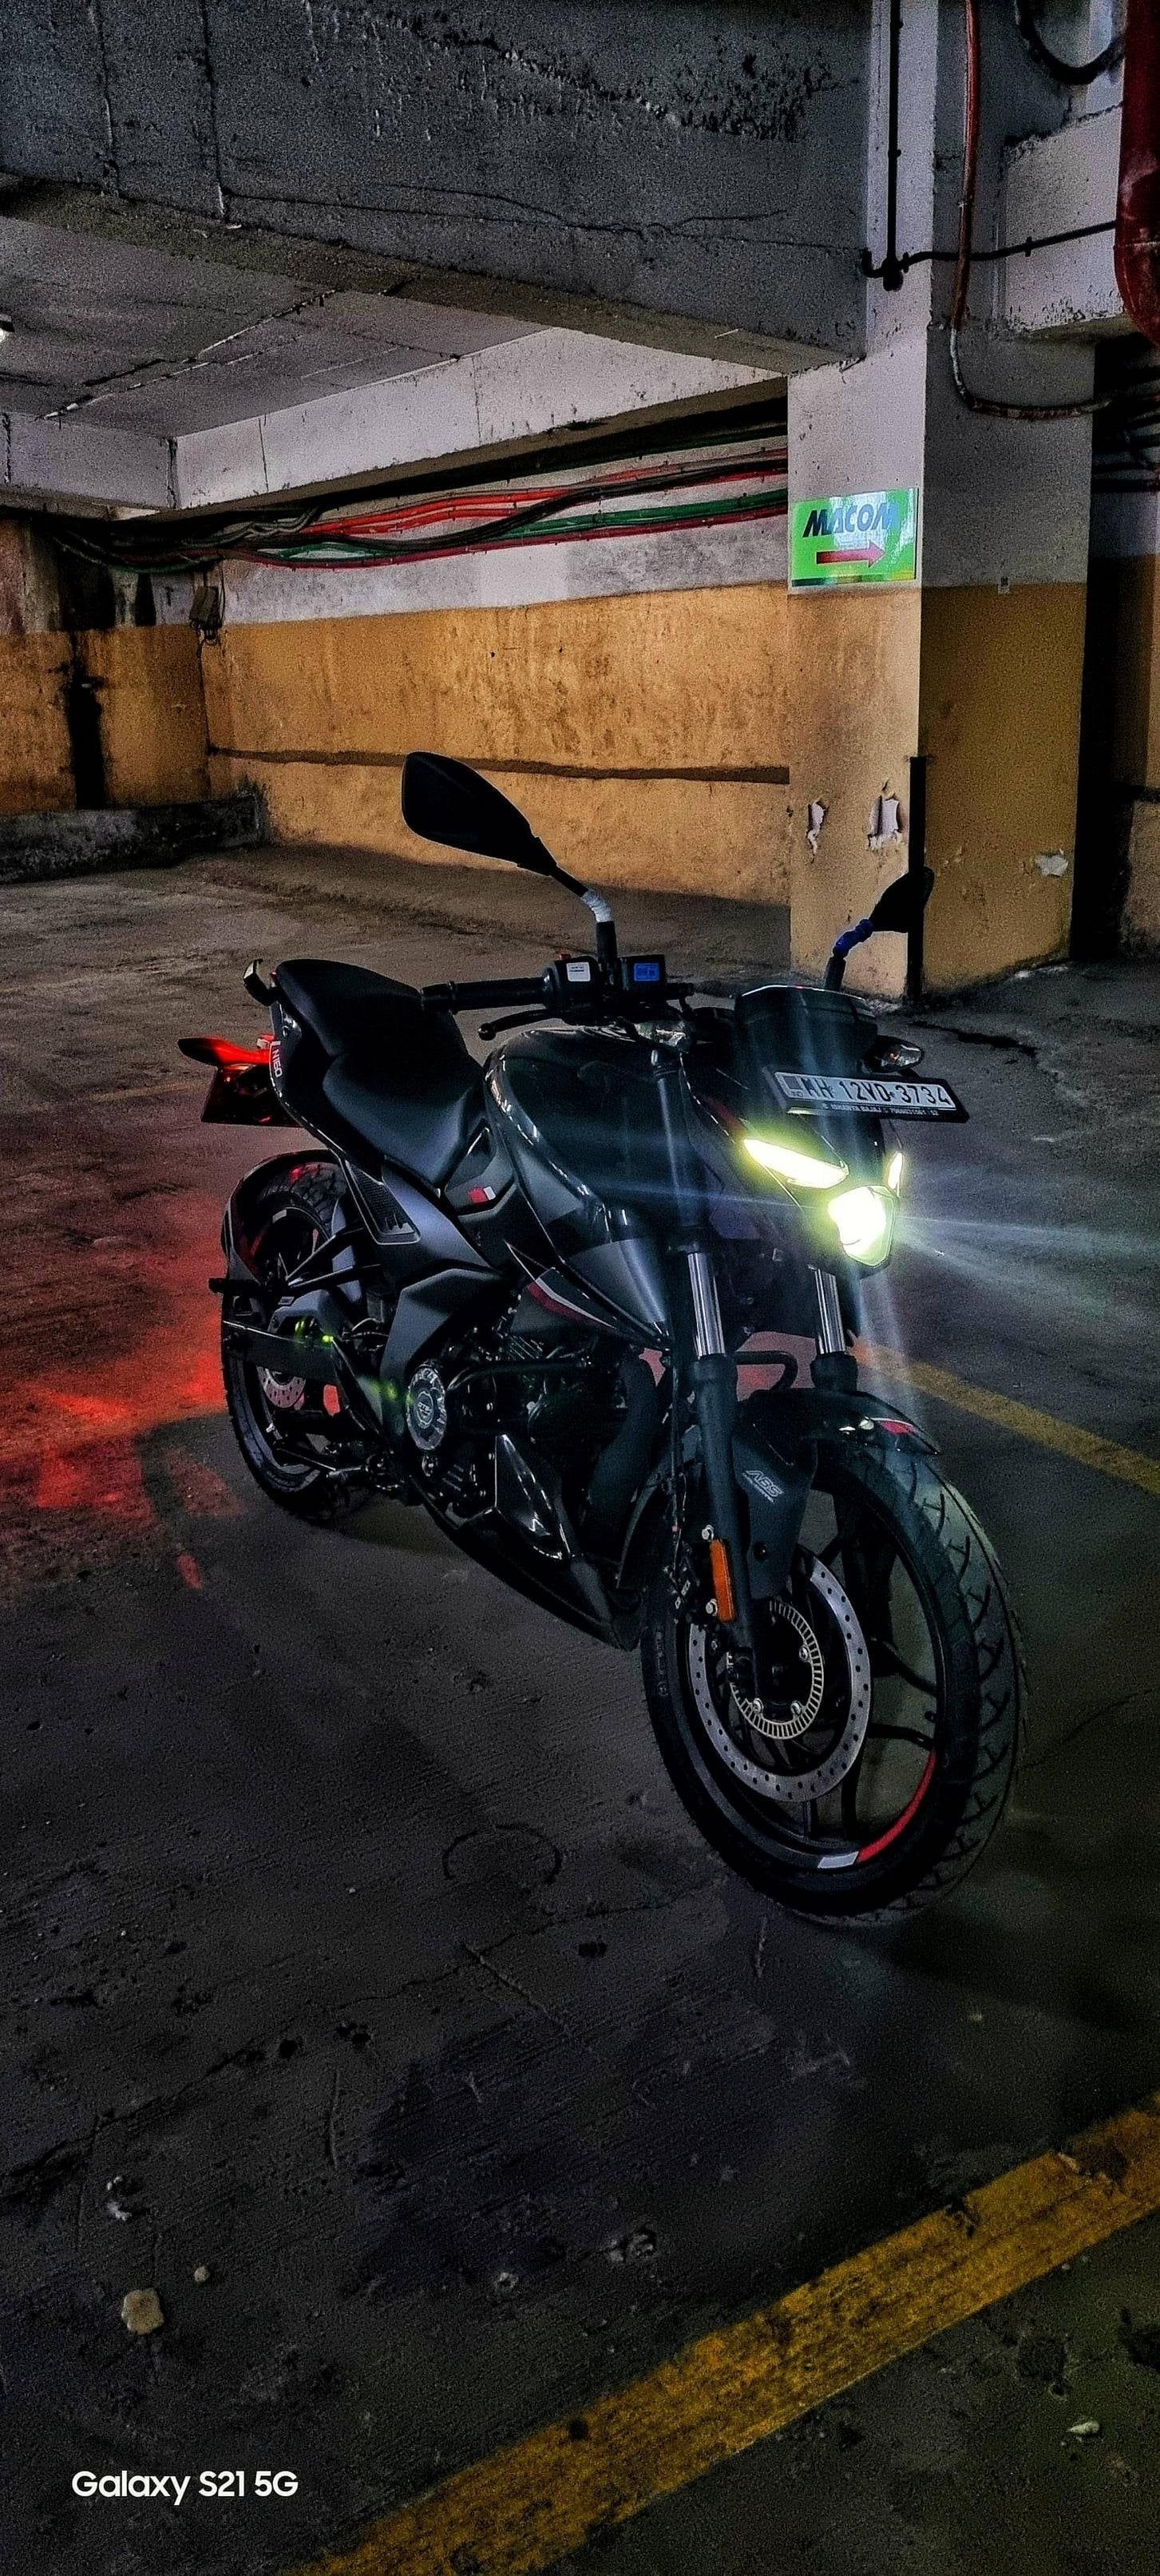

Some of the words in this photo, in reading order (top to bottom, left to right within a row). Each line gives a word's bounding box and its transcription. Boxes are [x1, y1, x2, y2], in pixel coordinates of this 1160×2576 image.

[802, 503, 899, 537] MACOM
[895, 1085, 950, 1105] 3734
[746, 1470, 783, 1497] ABS
